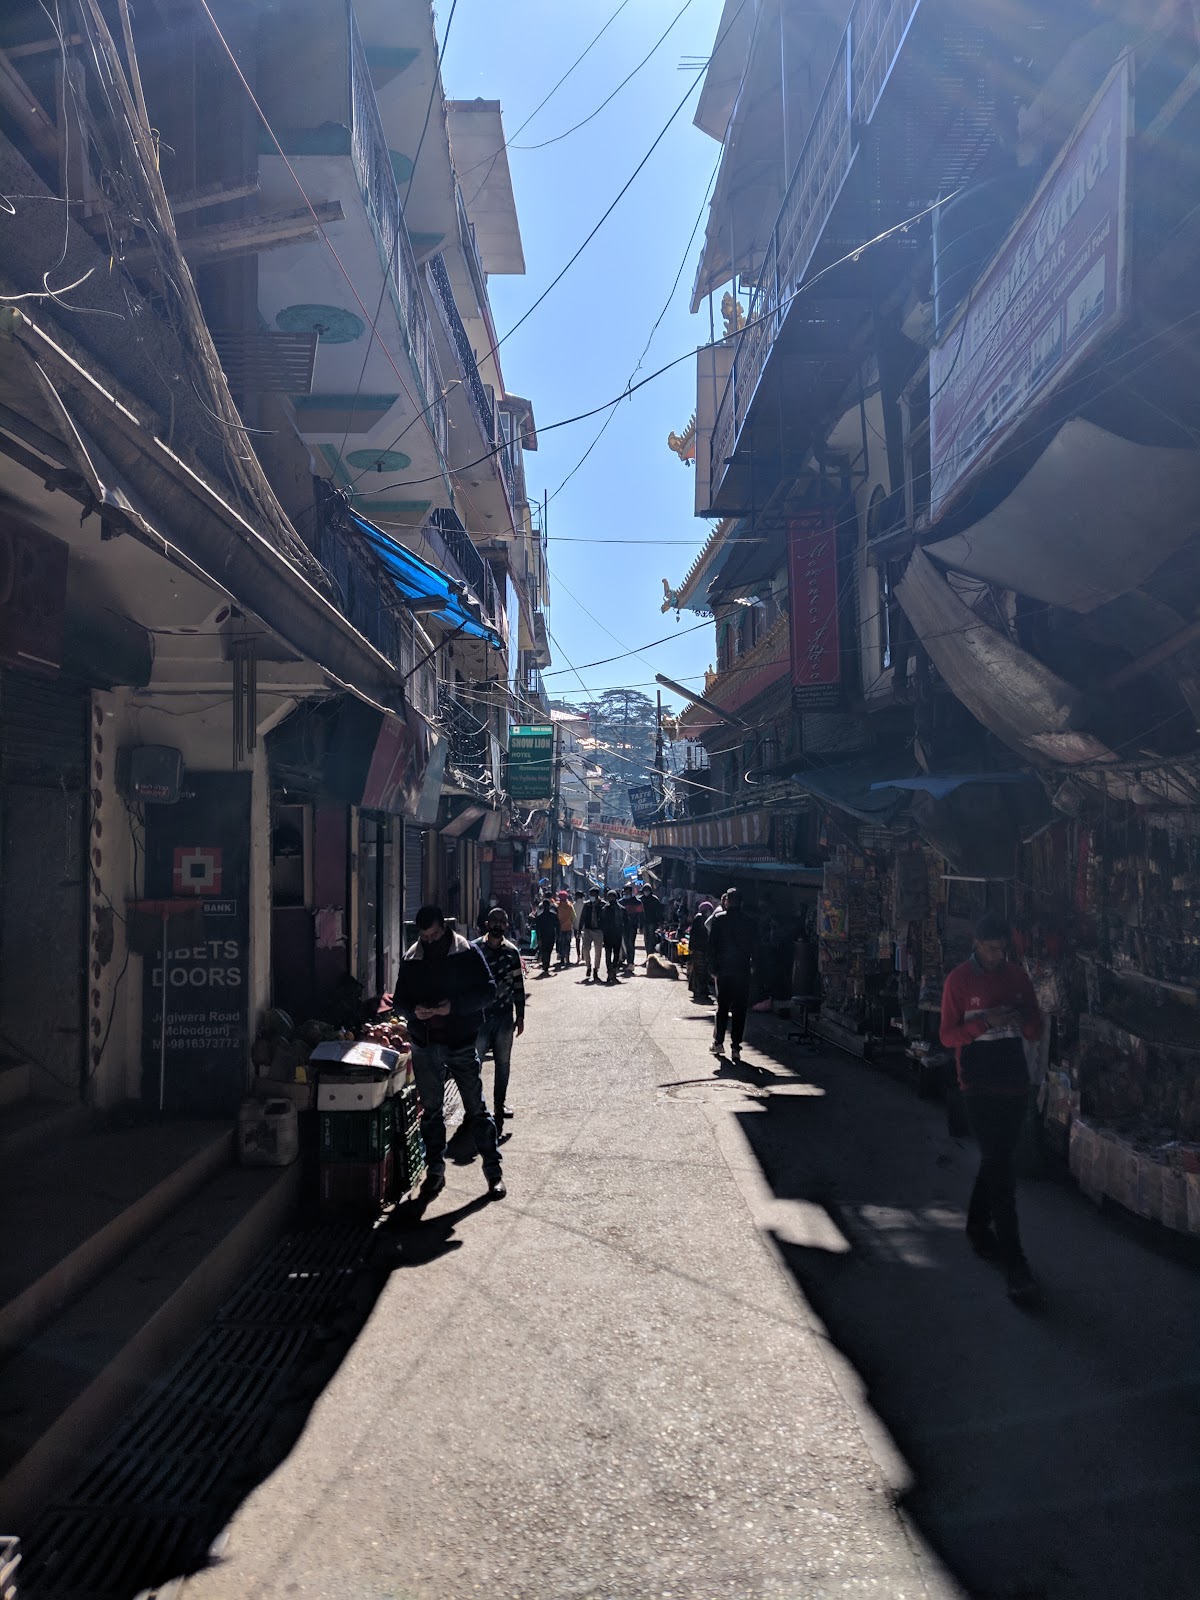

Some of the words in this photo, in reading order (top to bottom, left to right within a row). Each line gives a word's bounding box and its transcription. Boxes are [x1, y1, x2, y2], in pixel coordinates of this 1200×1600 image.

[970, 243, 1030, 350] Friends
[1034, 119, 1112, 264] Corner
[1014, 278, 1040, 323] BEER
[1042, 240, 1066, 286] BAR
[511, 738, 534, 748] SNOW
[534, 738, 551, 748] LION
[631, 791, 652, 800] TASTE
[637, 797, 647, 805] OF
[602, 823, 628, 834] BEAUTY
[628, 828, 650, 838] SALON
[204, 903, 232, 911] BANK
[152, 967, 242, 987] DOORS
[152, 1012, 206, 1025] Jgiwara
[209, 1011, 240, 1022] Road
